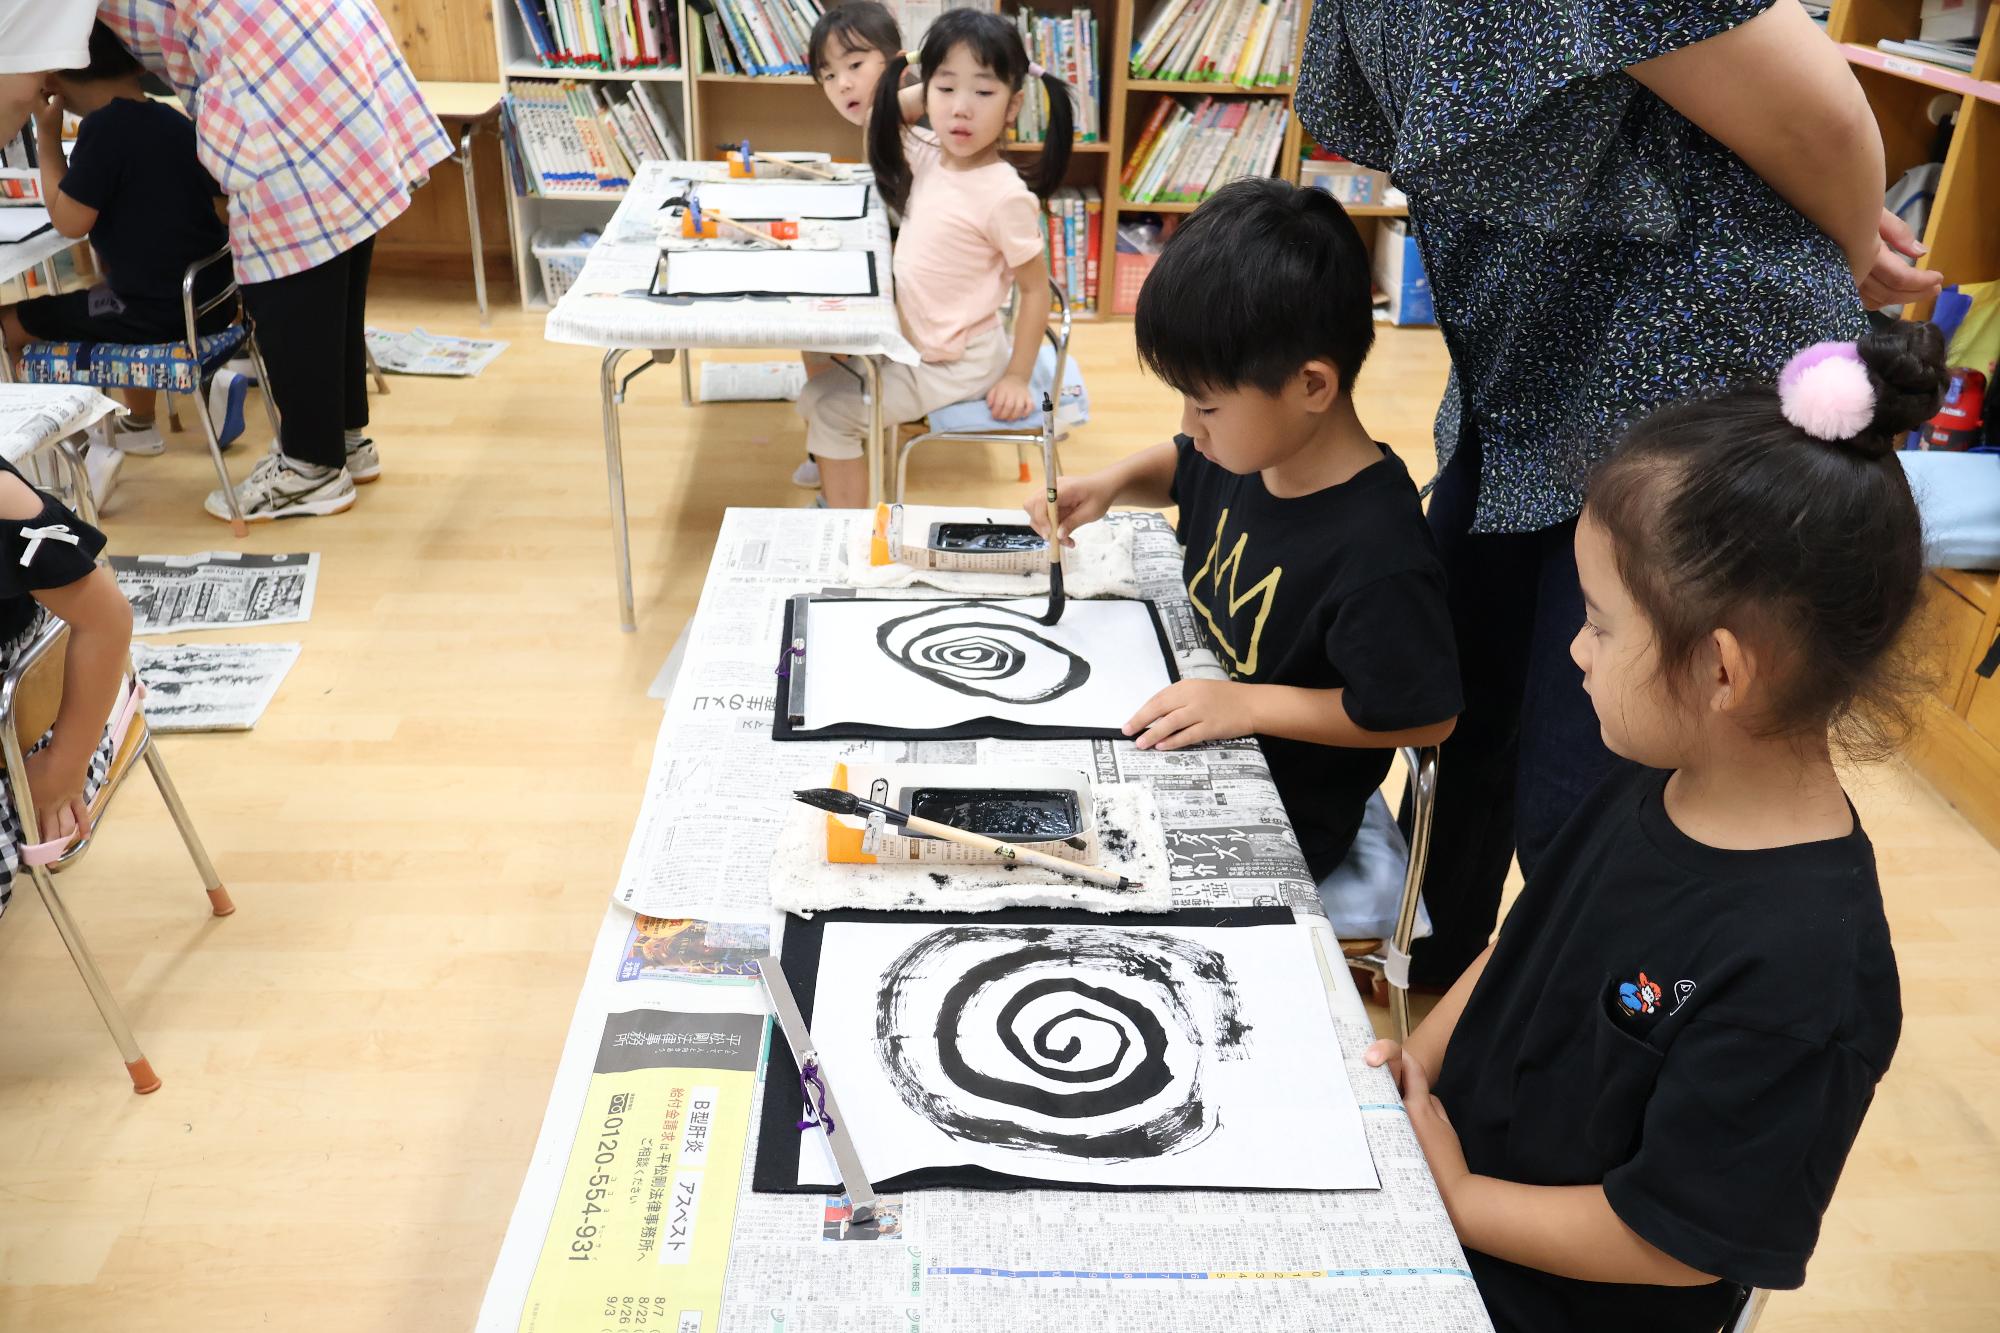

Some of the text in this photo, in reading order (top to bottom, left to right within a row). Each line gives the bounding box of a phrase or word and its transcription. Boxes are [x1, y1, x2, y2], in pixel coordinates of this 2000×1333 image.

[614, 1030, 742, 1048] 平松剛法律事務所
[684, 1100, 711, 1153] B型肝炎
[628, 1136, 654, 1206] ご相談ください
[636, 1086, 686, 1262] 給付金請求は平松剛法律事務所へ
[568, 1117, 625, 1262] 0120-554-931
[667, 1181, 697, 1252] アスベスト
[912, 1263, 920, 1279] NHK
[911, 1281, 920, 1292] BS
[604, 1296, 618, 1316] 9/3
[619, 1296, 634, 1324] 8/26
[635, 1296, 650, 1324] 8/22
[653, 1296, 666, 1317] 8/7
